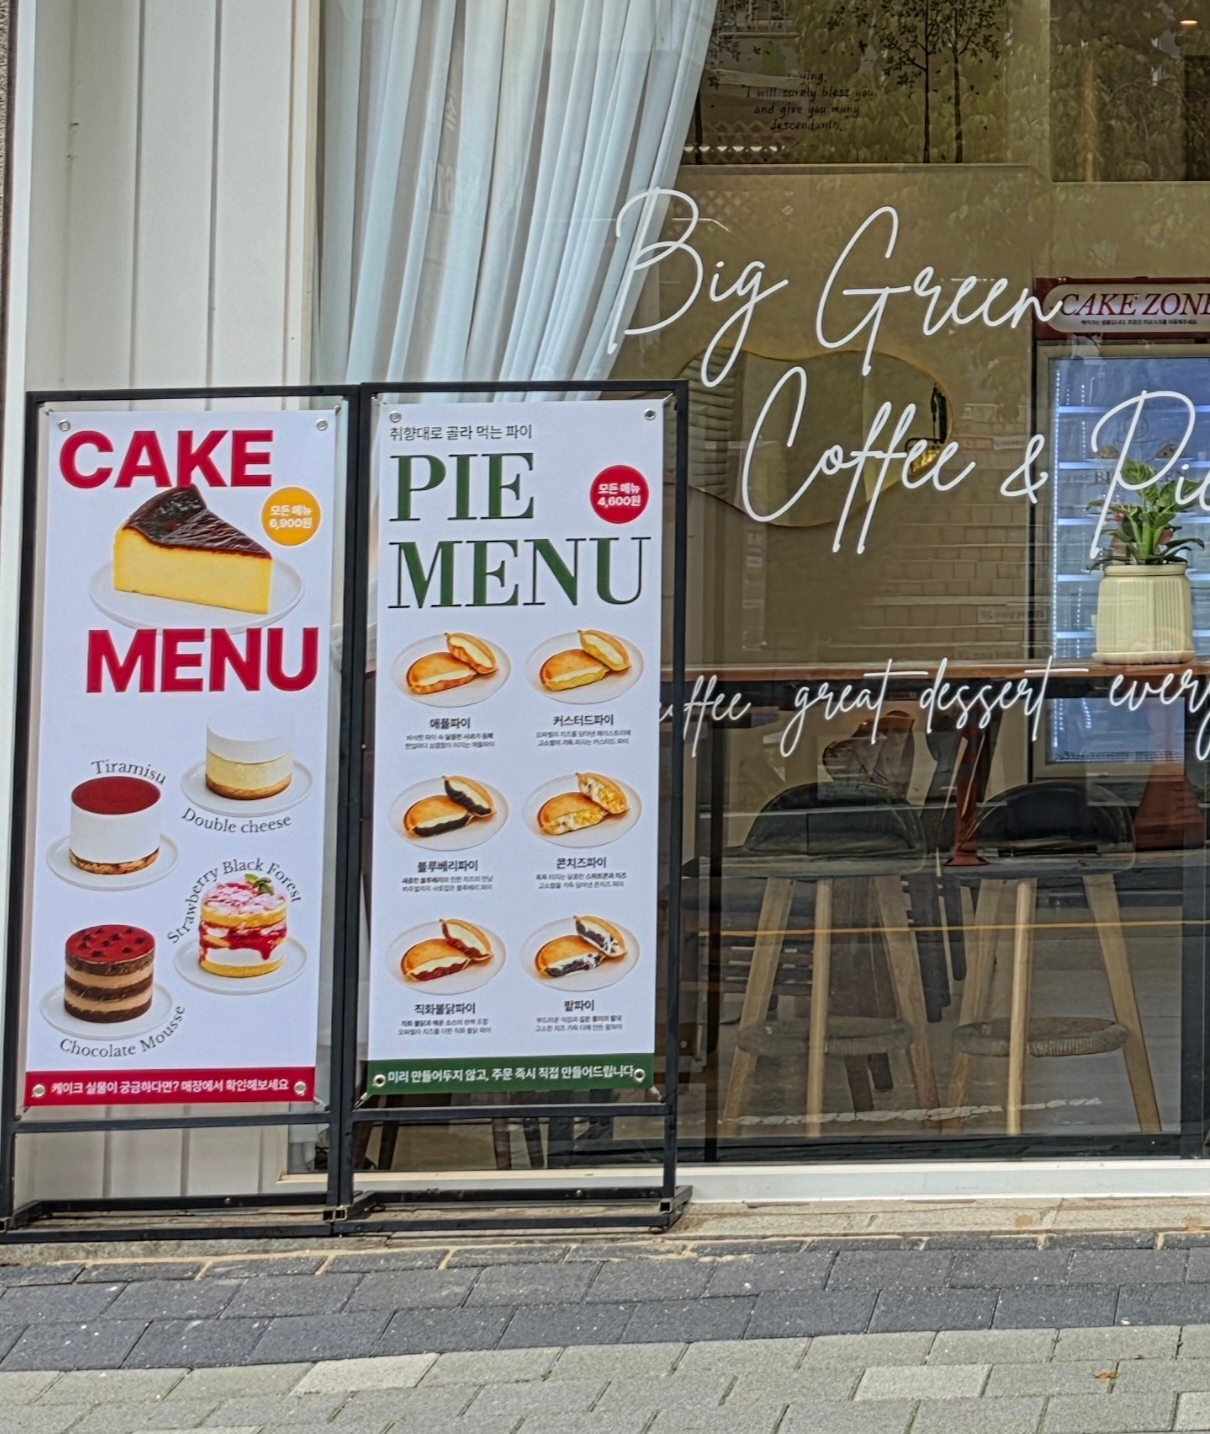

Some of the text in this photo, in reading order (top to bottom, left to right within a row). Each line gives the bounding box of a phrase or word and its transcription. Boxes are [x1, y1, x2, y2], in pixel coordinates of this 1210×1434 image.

[757, 88, 776, 98] will
[782, 88, 817, 102] surely
[753, 104, 774, 114] and
[780, 103, 803, 119] give
[808, 106, 826, 118] you
[607, 187, 1064, 387] Big Green
[1061, 293, 1138, 316] CAKE
[390, 424, 533, 441] 취향대로 골라 먹는 파이
[59, 429, 274, 488] CAKE
[742, 366, 975, 554] Coffee
[999, 433, 1054, 504] &
[389, 452, 534, 522] PIE
[596, 495, 641, 508] 4,600원
[388, 536, 652, 608] MENU
[86, 627, 319, 693] MENU
[553, 714, 614, 726] 커스터드파이
[660, 675, 752, 758] ffee
[780, 658, 929, 759] great
[920, 656, 1090, 741] dessert
[90, 758, 167, 786] Tiramisu
[182, 807, 292, 833] Double cheese
[417, 860, 478, 873] 블루베리파이
[166, 857, 302, 944] Strawberry Black Forest
[59, 1004, 186, 1058] Chocolate Mousse
[50, 1078, 289, 1095] 케이크 실물이 궁금하다면? 매장에서 확인해보세요
[388, 1065, 634, 1083] 미리 만들어두지 않고, 주문 즉시 직접 만들어드립니다
